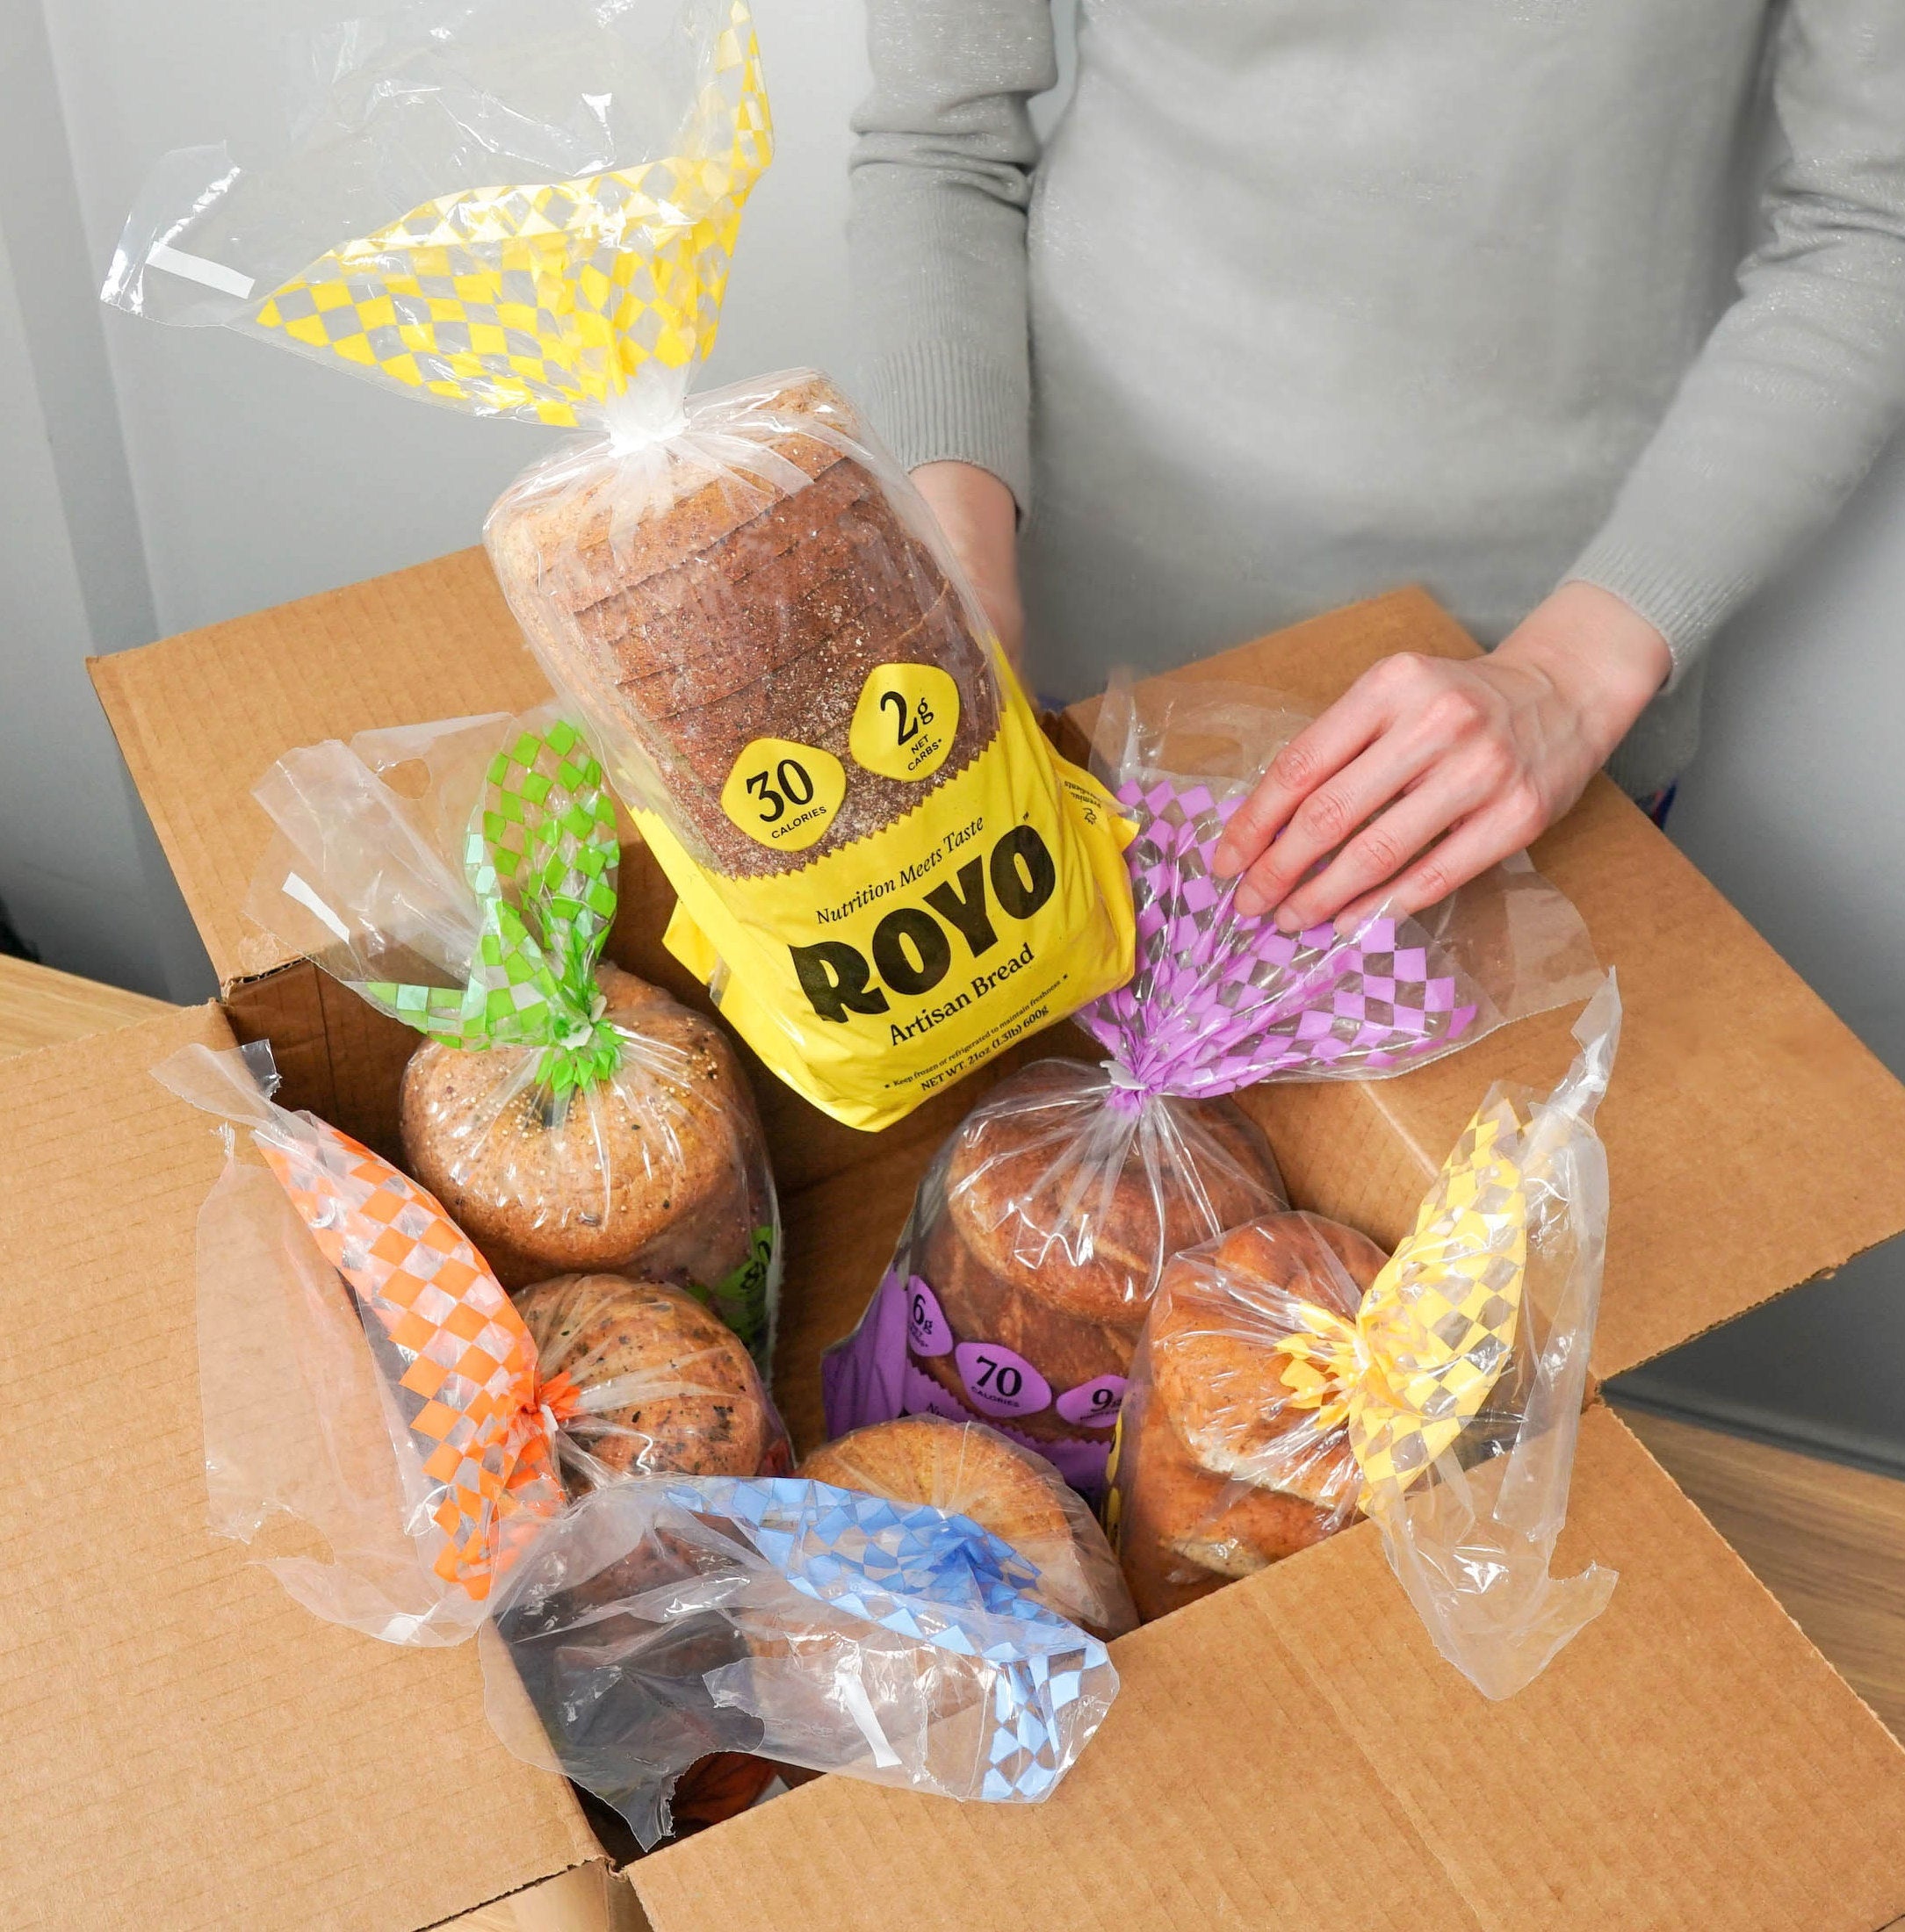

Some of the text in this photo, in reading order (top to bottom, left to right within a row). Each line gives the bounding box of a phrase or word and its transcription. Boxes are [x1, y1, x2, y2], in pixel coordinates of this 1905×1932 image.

[880, 690, 934, 746] 2g
[911, 733, 929, 753] NET
[747, 759, 813, 822] 30
[771, 806, 826, 839] CALORIES
[816, 817, 984, 925] Nutrition Meets Taste
[789, 825, 1056, 1024] ROYO
[890, 943, 1035, 1046] Artisan Bread
[892, 980, 1061, 1086] Keep frozen or refrigerated to maintain freshness
[920, 1072, 945, 1092] NET
[967, 1048, 991, 1064] 21oz
[1023, 1006, 1050, 1028] 600g
[913, 1294, 933, 1335] 6g
[976, 1355, 1022, 1398] 70
